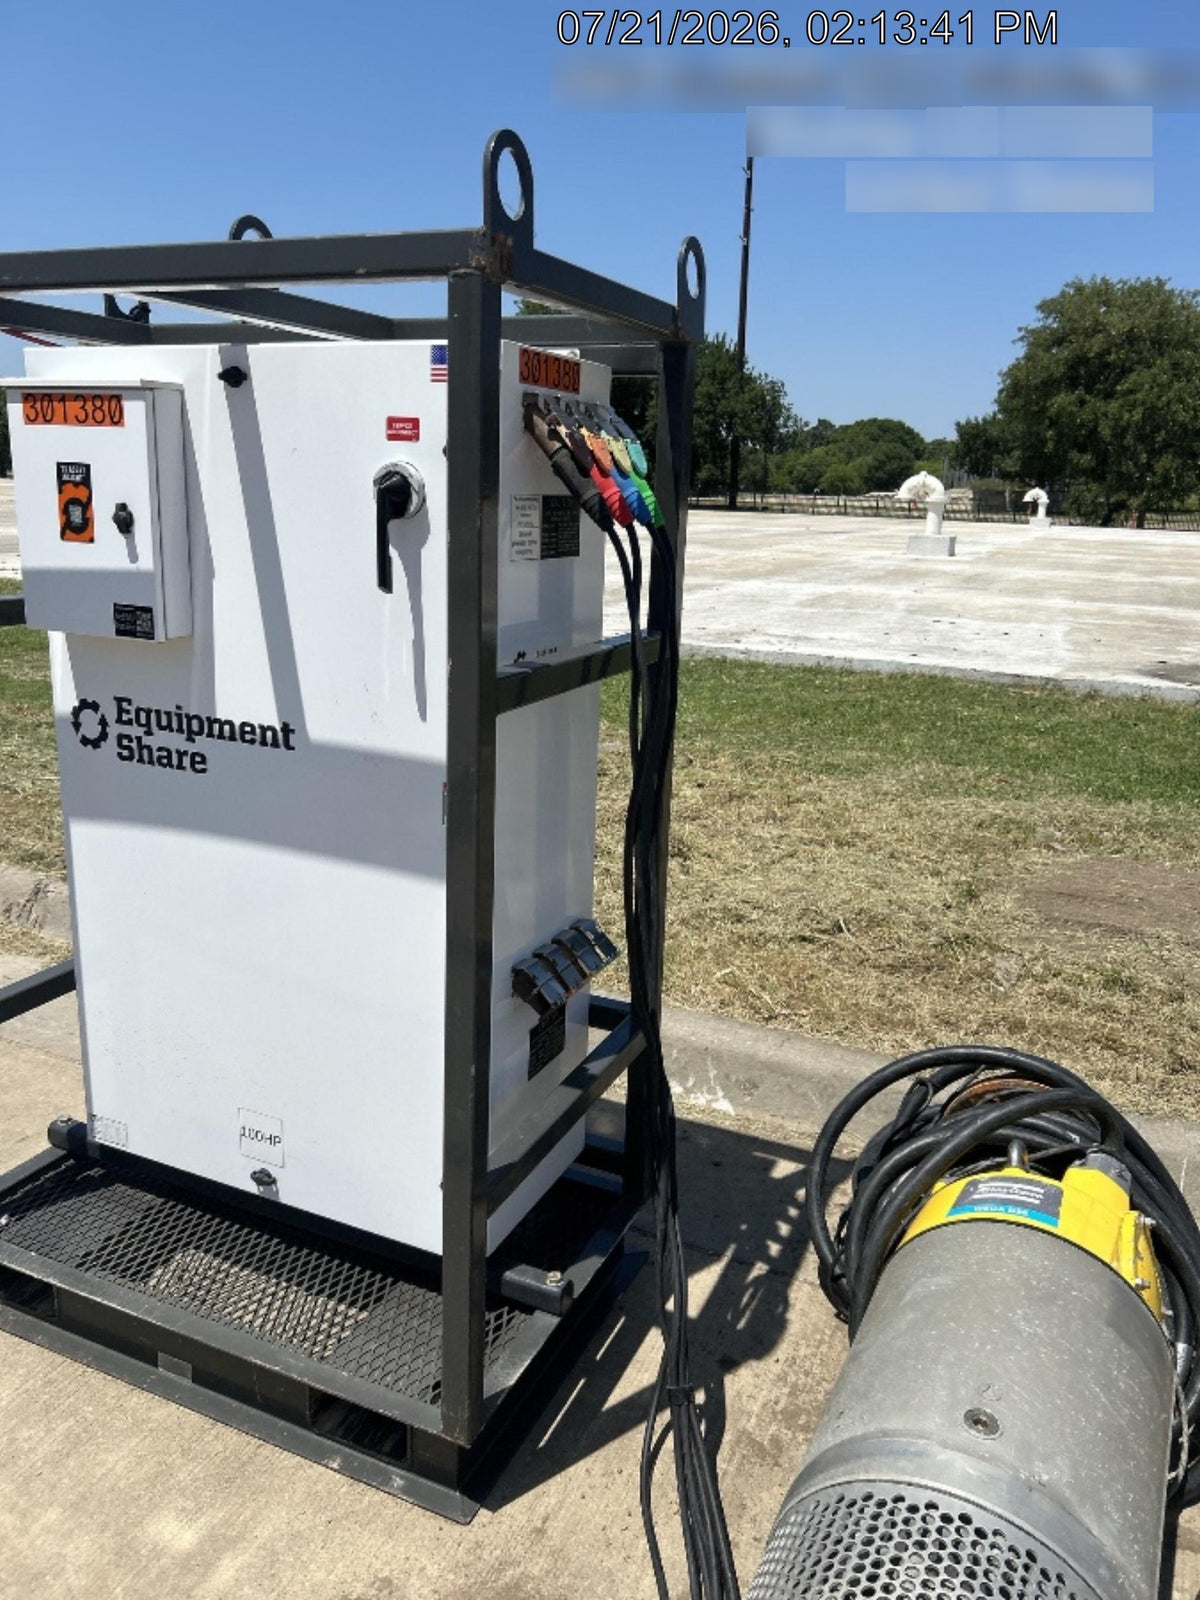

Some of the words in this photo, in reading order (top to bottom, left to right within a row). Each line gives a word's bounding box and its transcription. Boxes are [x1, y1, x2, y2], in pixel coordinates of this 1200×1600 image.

[520, 348, 580, 391] 301380
[24, 393, 123, 424] 301380
[113, 696, 296, 750] Equipment
[116, 733, 208, 773] Share
